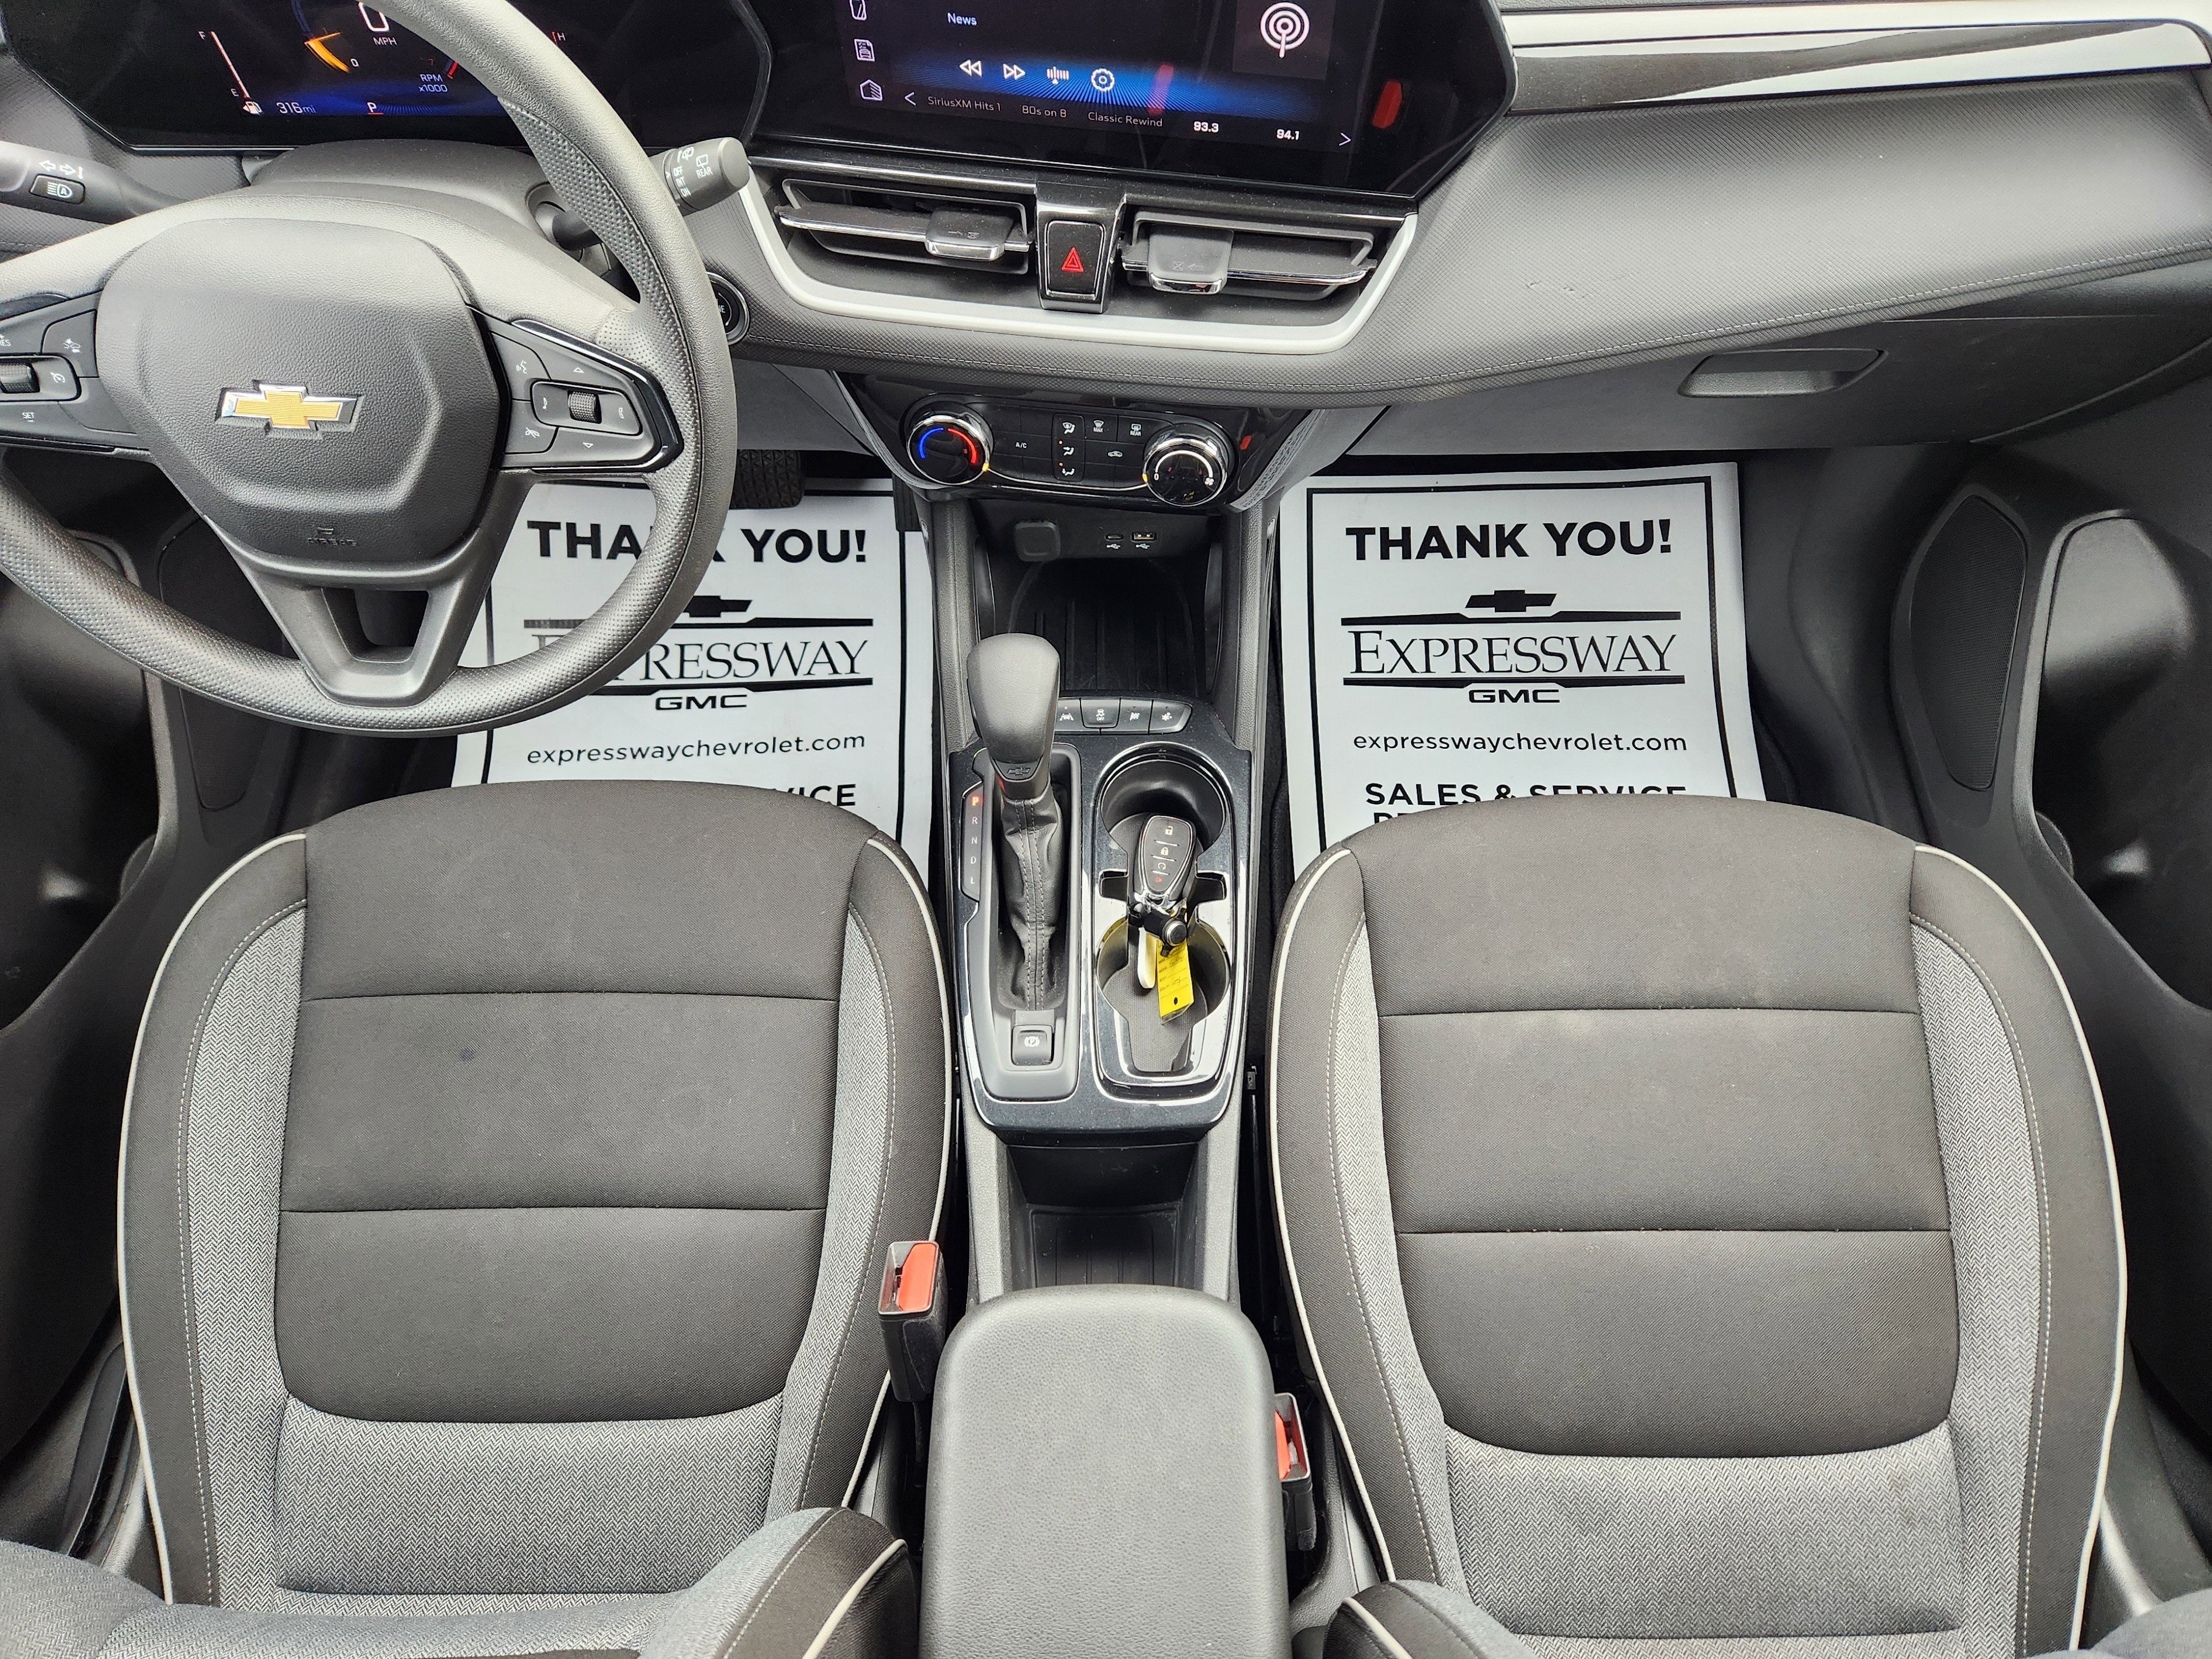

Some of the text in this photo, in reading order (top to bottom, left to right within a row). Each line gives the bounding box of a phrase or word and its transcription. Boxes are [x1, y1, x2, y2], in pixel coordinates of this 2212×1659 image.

[947, 12, 977, 26] News
[198, 31, 206, 40] F
[374, 37, 397, 46] MPH
[557, 32, 566, 41] H
[351, 59, 359, 67] 0
[420, 74, 443, 82] RPM
[419, 84, 447, 92] x1000
[367, 102, 377, 113] P
[927, 96, 1001, 111] SiriusXM Hits 1
[1022, 105, 1041, 115] 80s
[1087, 112, 1163, 127] Classic Rewind
[1193, 121, 1219, 133] 93.3
[1276, 128, 1300, 141] 94.1
[673, 165, 683, 177] OFF
[696, 166, 713, 179] REAR
[675, 176, 686, 188] INT
[680, 187, 692, 197] ON
[526, 520, 867, 564] THA YOU!
[1345, 519, 1672, 561] THANK YOU!
[531, 634, 868, 681] RESSWAY
[1348, 630, 1677, 674] EXPRESSWAY
[655, 694, 748, 711] GMC
[1468, 689, 1561, 704] GMC
[1353, 733, 1688, 753] expresswaychevrolet.com
[527, 734, 865, 765] expresswaychevrolet.com
[1365, 782, 1481, 806] SALES
[972, 796, 979, 806] P
[972, 816, 978, 825] R
[971, 836, 978, 844] N
[971, 856, 977, 864] D
